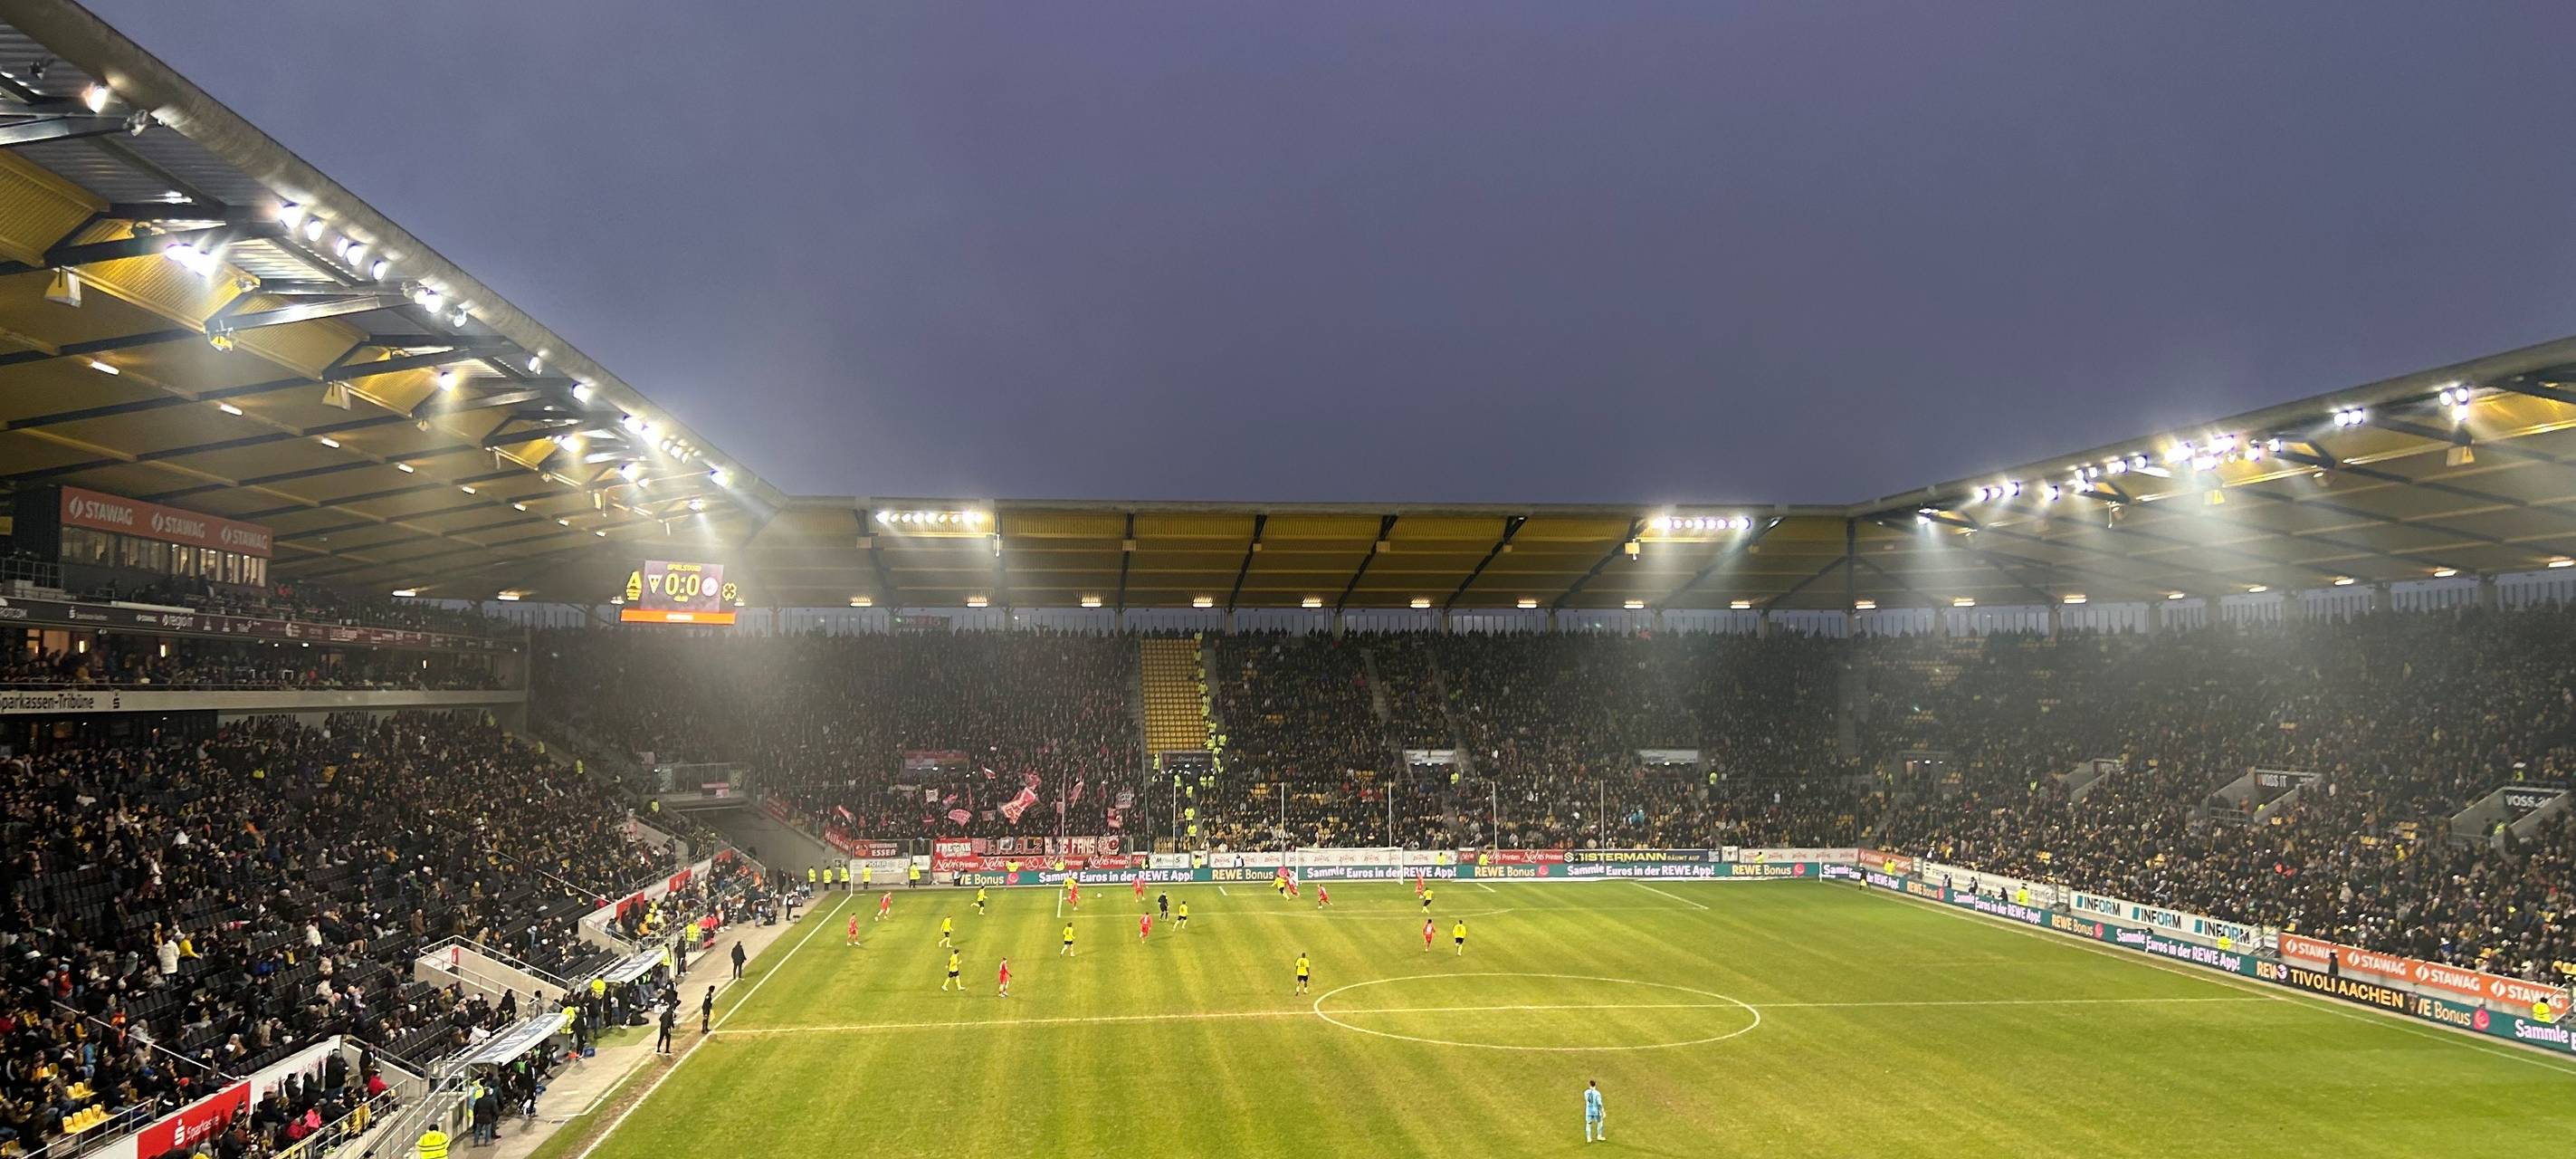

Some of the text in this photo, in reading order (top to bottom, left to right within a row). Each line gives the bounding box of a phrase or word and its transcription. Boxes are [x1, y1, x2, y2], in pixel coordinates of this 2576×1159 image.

[85, 502, 133, 526] STAWAG
[165, 516, 205, 538] STAWAG
[232, 530, 268, 550] STAWAG
[664, 573, 701, 596] 0:0
[1072, 838, 1095, 854] FANS
[933, 859, 959, 872] Nobis
[979, 857, 1006, 870] Nobis
[1307, 867, 1457, 878] Sammle Euros in der REWE App!
[1474, 867, 1535, 877] REWE Bonus
[1568, 864, 1715, 877] Sammle Euros in der REWE App!
[1732, 865, 1791, 876] REWE Bonus
[975, 874, 1005, 885] Bonus
[1039, 870, 1194, 883] Sammle Euros in der REWE App!
[1212, 869, 1274, 880] REWE Bonus
[1823, 865, 1849, 875] Sammle
[1875, 874, 1888, 887] REWE
[1907, 880, 1923, 895] REWE
[1953, 892, 2041, 924] Sammle Euros in der REWE App!
[2085, 896, 2121, 916] INFORM
[2052, 915, 2093, 936] REWE Bonus
[2142, 908, 2181, 929] INFORM
[2205, 921, 2250, 943] INFORM
[2116, 928, 2240, 972] Sammle Euros in der REWE App!
[2361, 957, 2406, 975] STAWAG
[2431, 969, 2481, 991] STAWAG
[2290, 969, 2335, 992] TIVOLI
[2338, 980, 2403, 1009] AACHEN
[2434, 1001, 2471, 1027] Bonus
[2507, 984, 2563, 1010] STAWAG
[2515, 1019, 2569, 1044] Sammle
